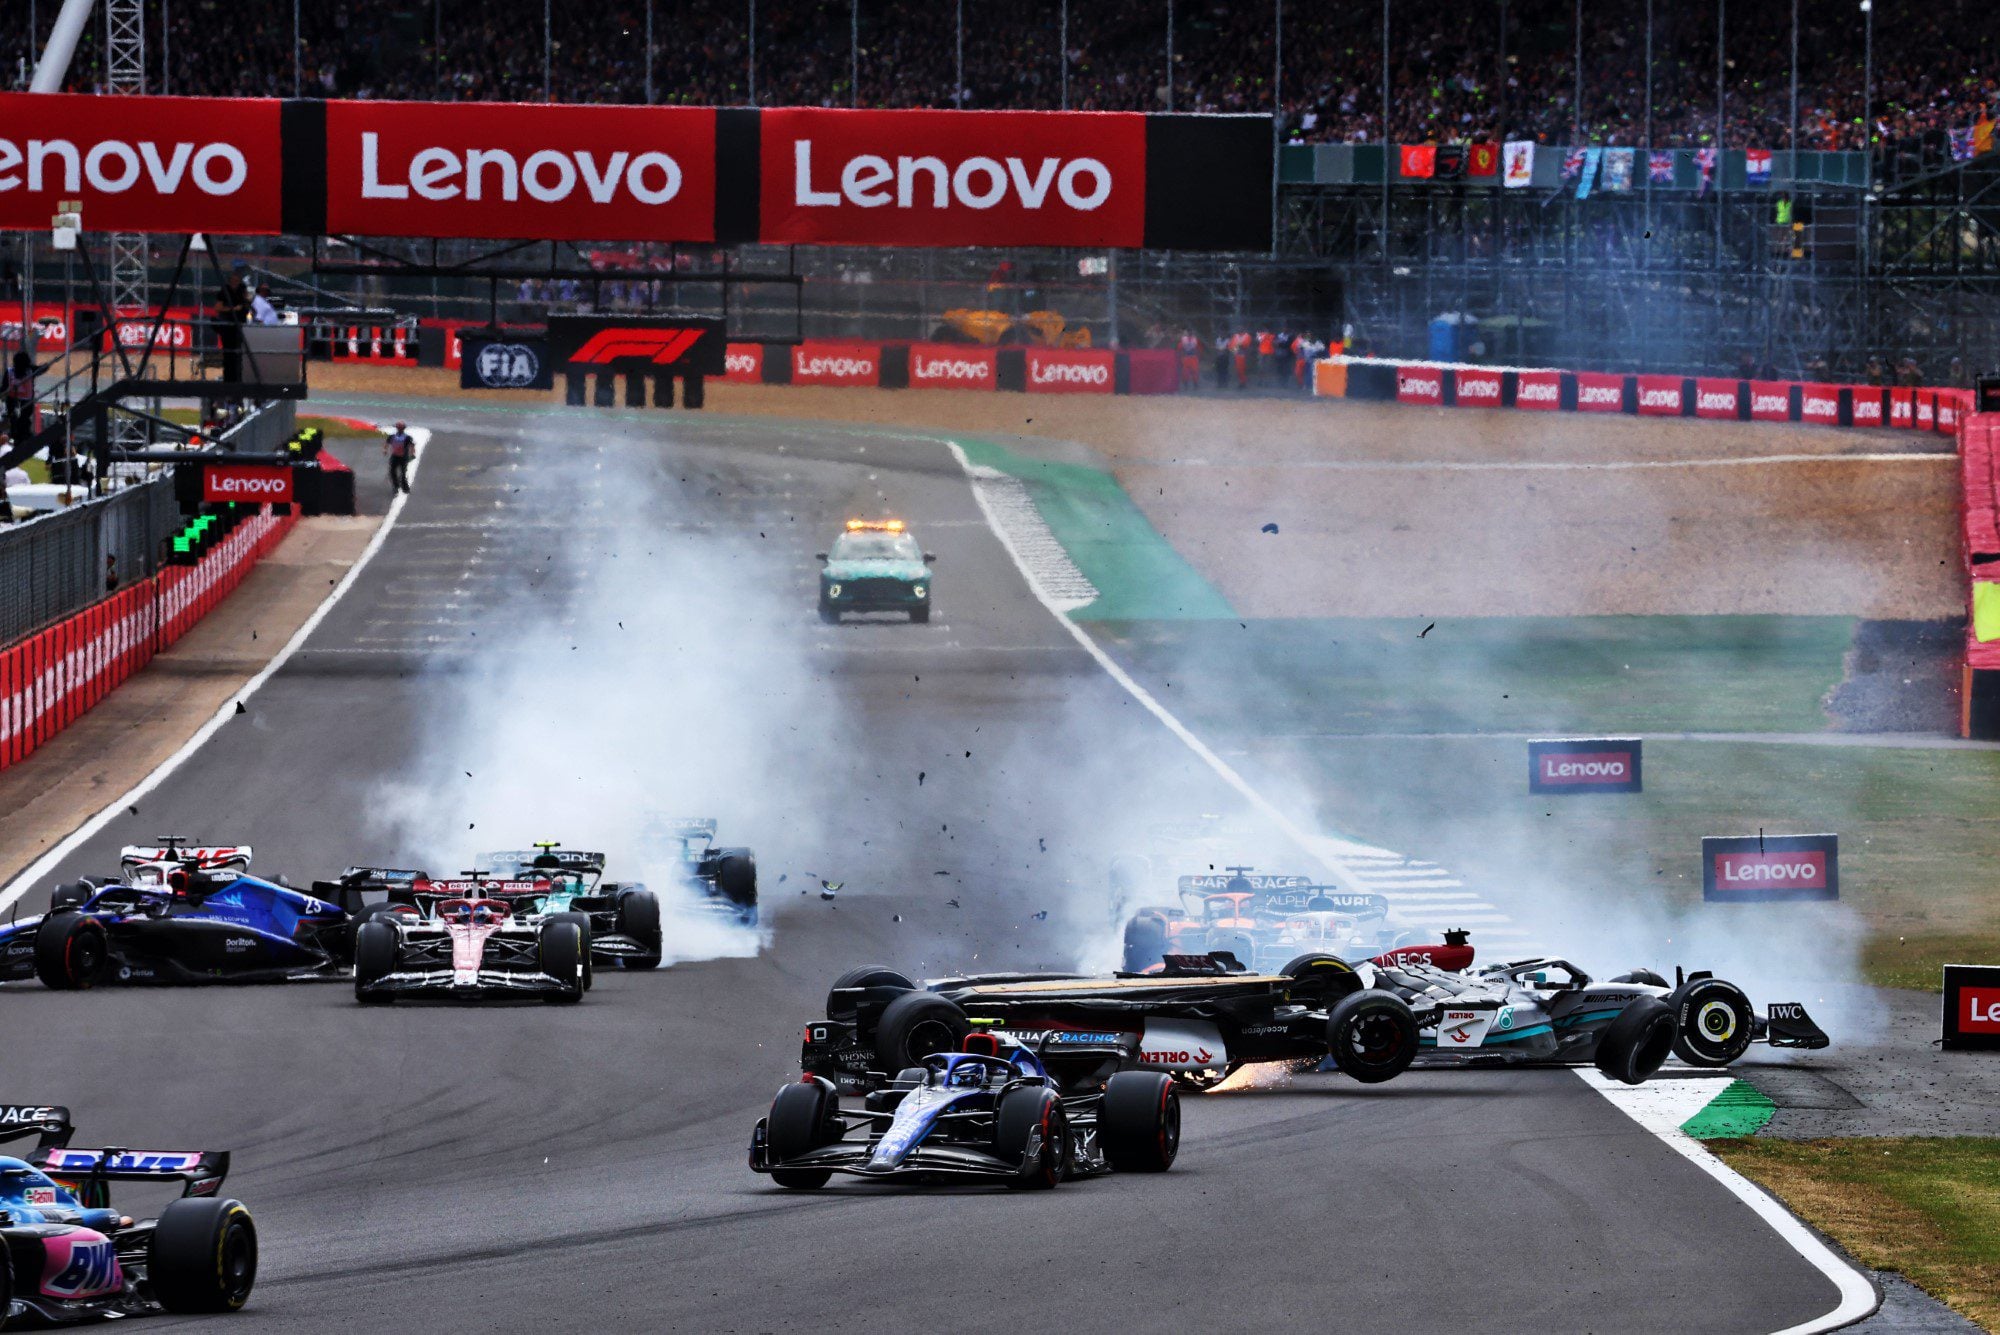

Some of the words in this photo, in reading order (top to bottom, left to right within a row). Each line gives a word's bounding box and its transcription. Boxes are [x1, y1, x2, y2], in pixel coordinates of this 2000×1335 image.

[361, 131, 682, 204] Lenovo
[795, 139, 1112, 210] Lenovo
[482, 353, 530, 377] FIA
[797, 352, 872, 377] Lenovo
[915, 355, 988, 379] Lenovo
[1031, 358, 1109, 384] Lenovo
[211, 473, 286, 494] Lenovo
[1546, 759, 1625, 778] Lenovo
[1724, 859, 1817, 882] Lenovo
[1191, 876, 1297, 889] DARRACE
[305, 899, 322, 914] 23
[1380, 952, 1432, 967] INEOS
[1448, 1011, 1475, 1019] ORLEN
[1769, 1005, 1802, 1020] IWC
[1060, 1032, 1115, 1043] RACING
[839, 1052, 875, 1063] SINGHA
[1139, 1050, 1190, 1064] ORLEN
